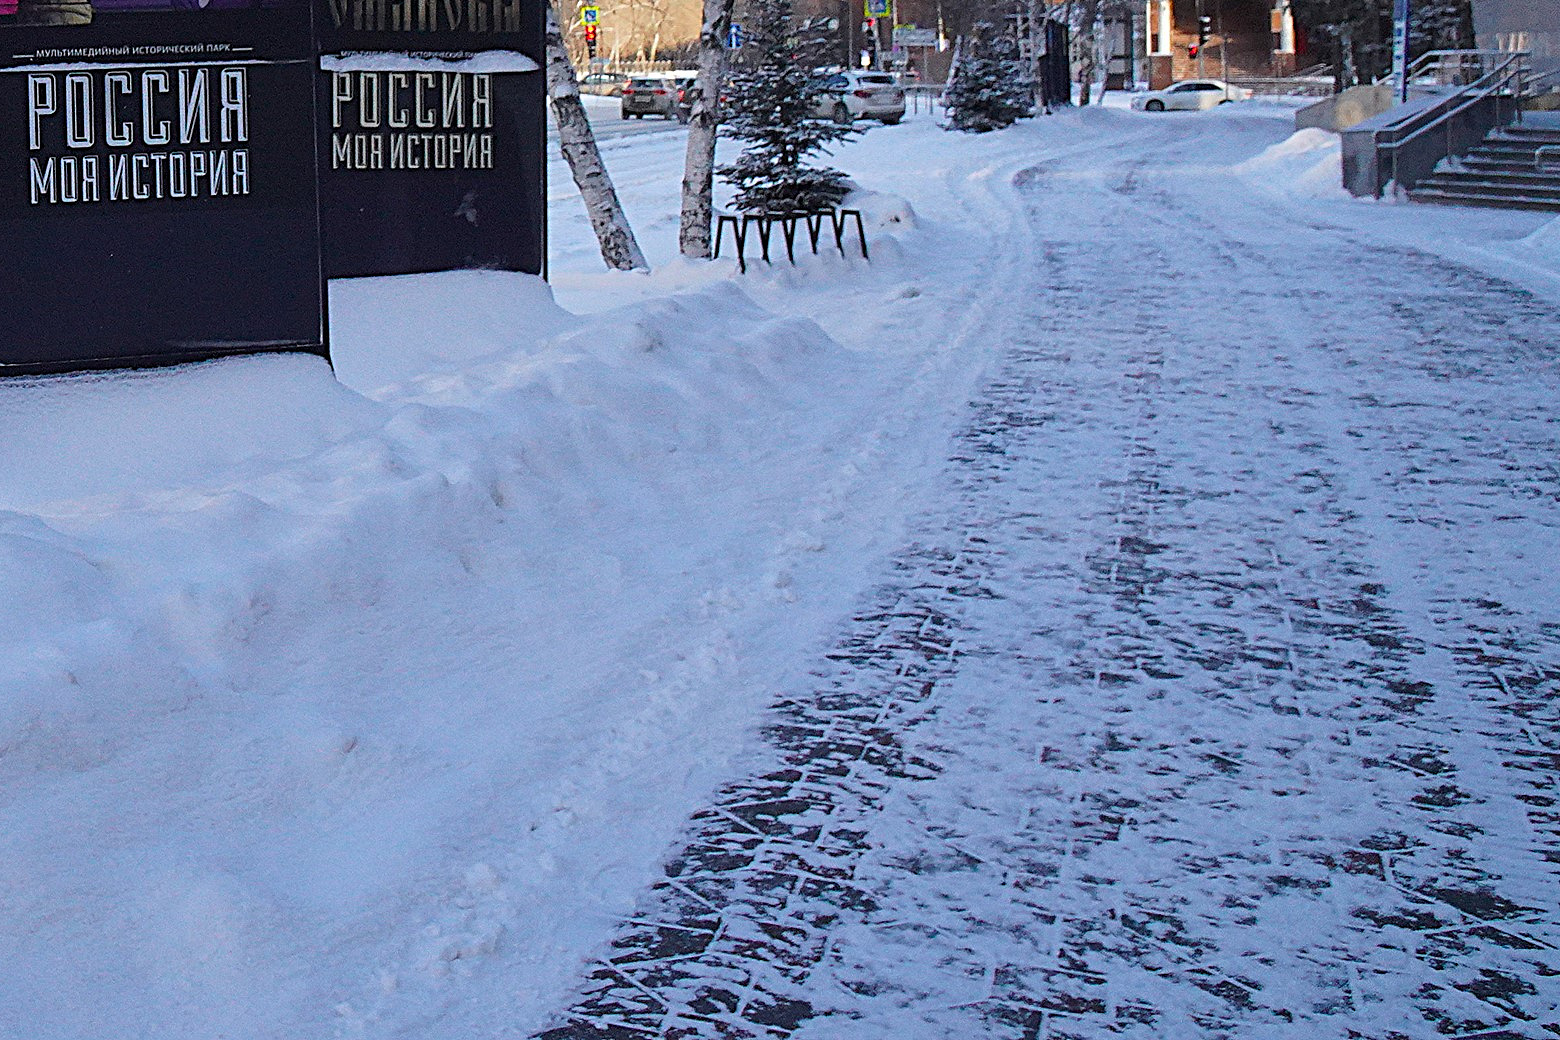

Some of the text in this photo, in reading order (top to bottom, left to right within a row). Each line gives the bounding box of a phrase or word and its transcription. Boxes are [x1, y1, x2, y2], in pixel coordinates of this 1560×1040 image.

[36, 44, 231, 58] МУЛЬТИМЕДИЙНЫЙ ИСТОРИЧЕСКИЙ ПАРК
[28, 67, 249, 150] РОССИЯ
[332, 72, 494, 128] РОССИЯ
[30, 149, 250, 205] МОЯ ИСТОРИЯ
[332, 133, 494, 169] МОЯ ИСТОРИЯ
